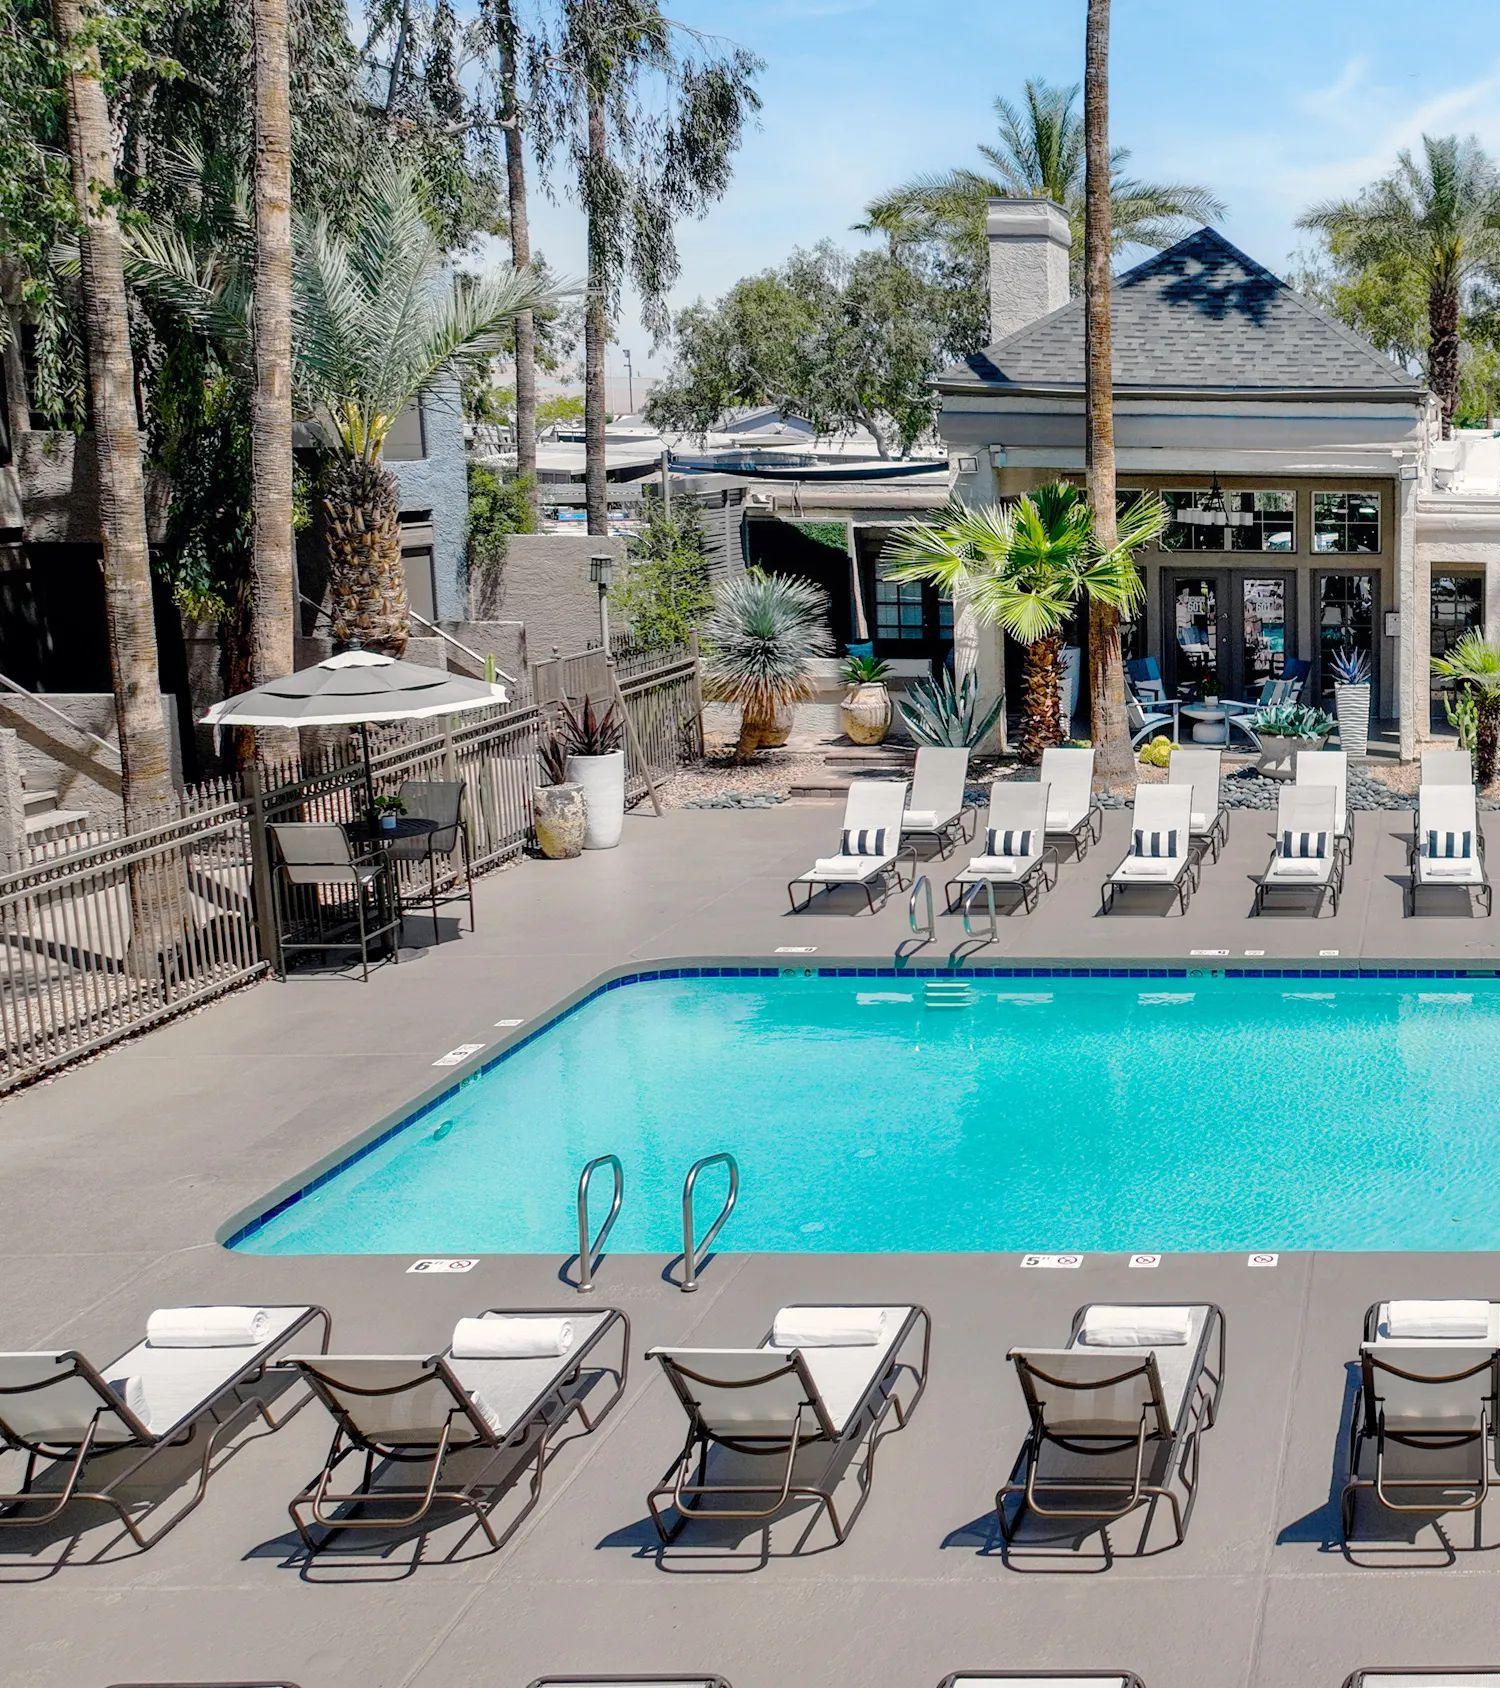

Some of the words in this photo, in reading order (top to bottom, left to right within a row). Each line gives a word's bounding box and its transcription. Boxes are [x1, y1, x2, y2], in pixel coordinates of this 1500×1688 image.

[1187, 602, 1203, 612] 601
[414, 1261, 433, 1271] 6
[1026, 1256, 1040, 1266] 5
